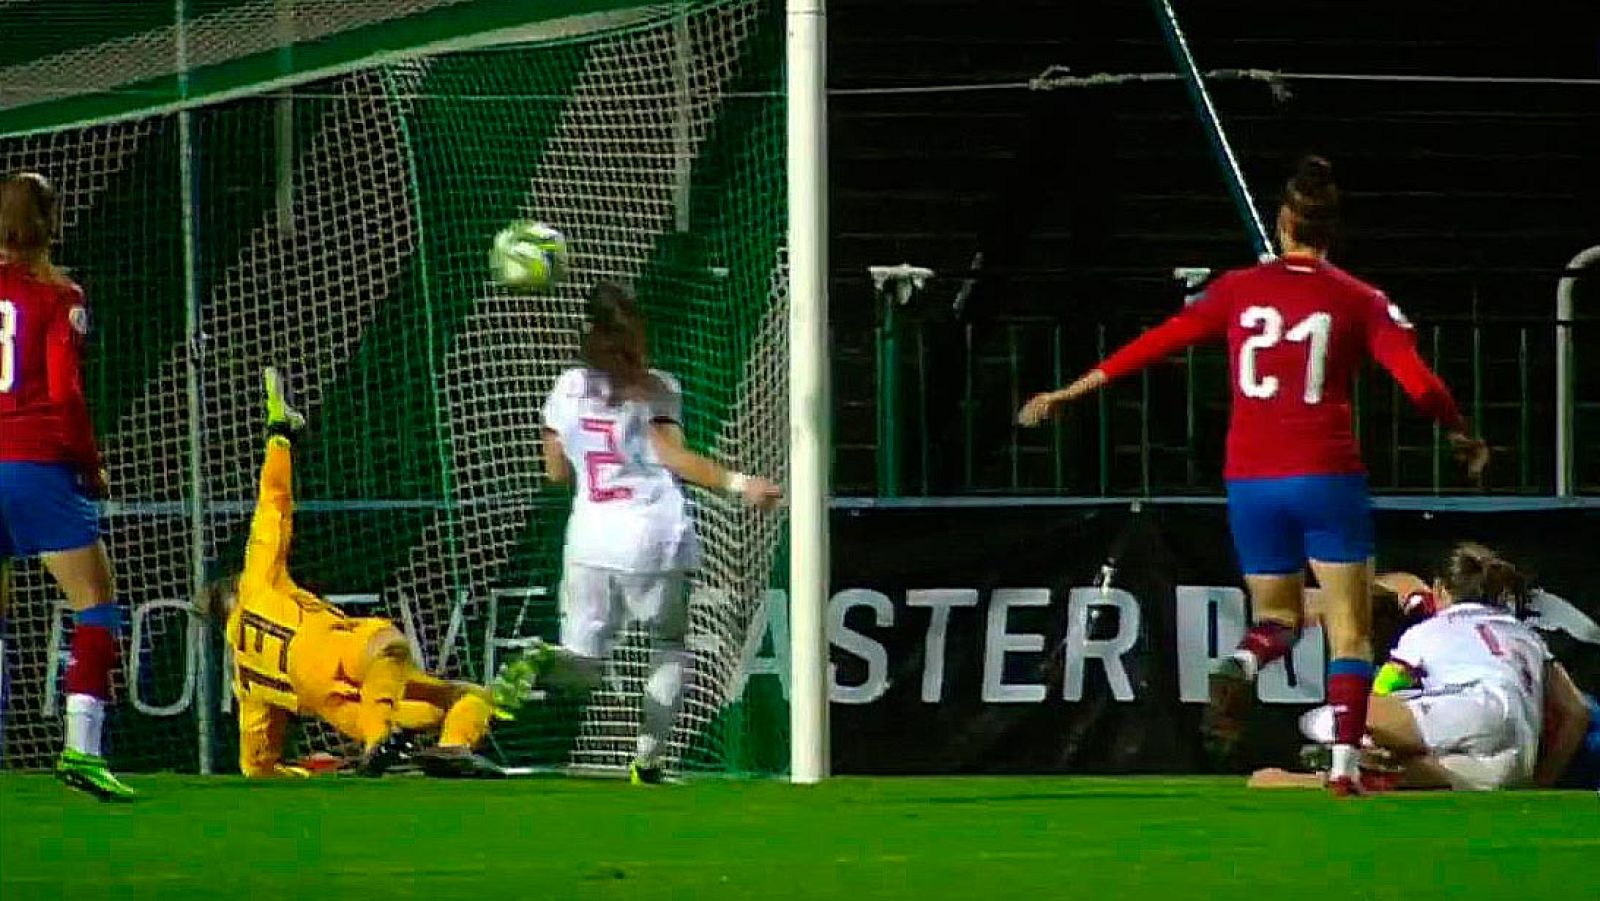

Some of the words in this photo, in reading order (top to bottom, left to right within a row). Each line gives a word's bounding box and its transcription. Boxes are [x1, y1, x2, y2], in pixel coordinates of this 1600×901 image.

[1239, 305, 1332, 404] 21
[579, 417, 634, 502] 2
[236, 607, 297, 694] 13
